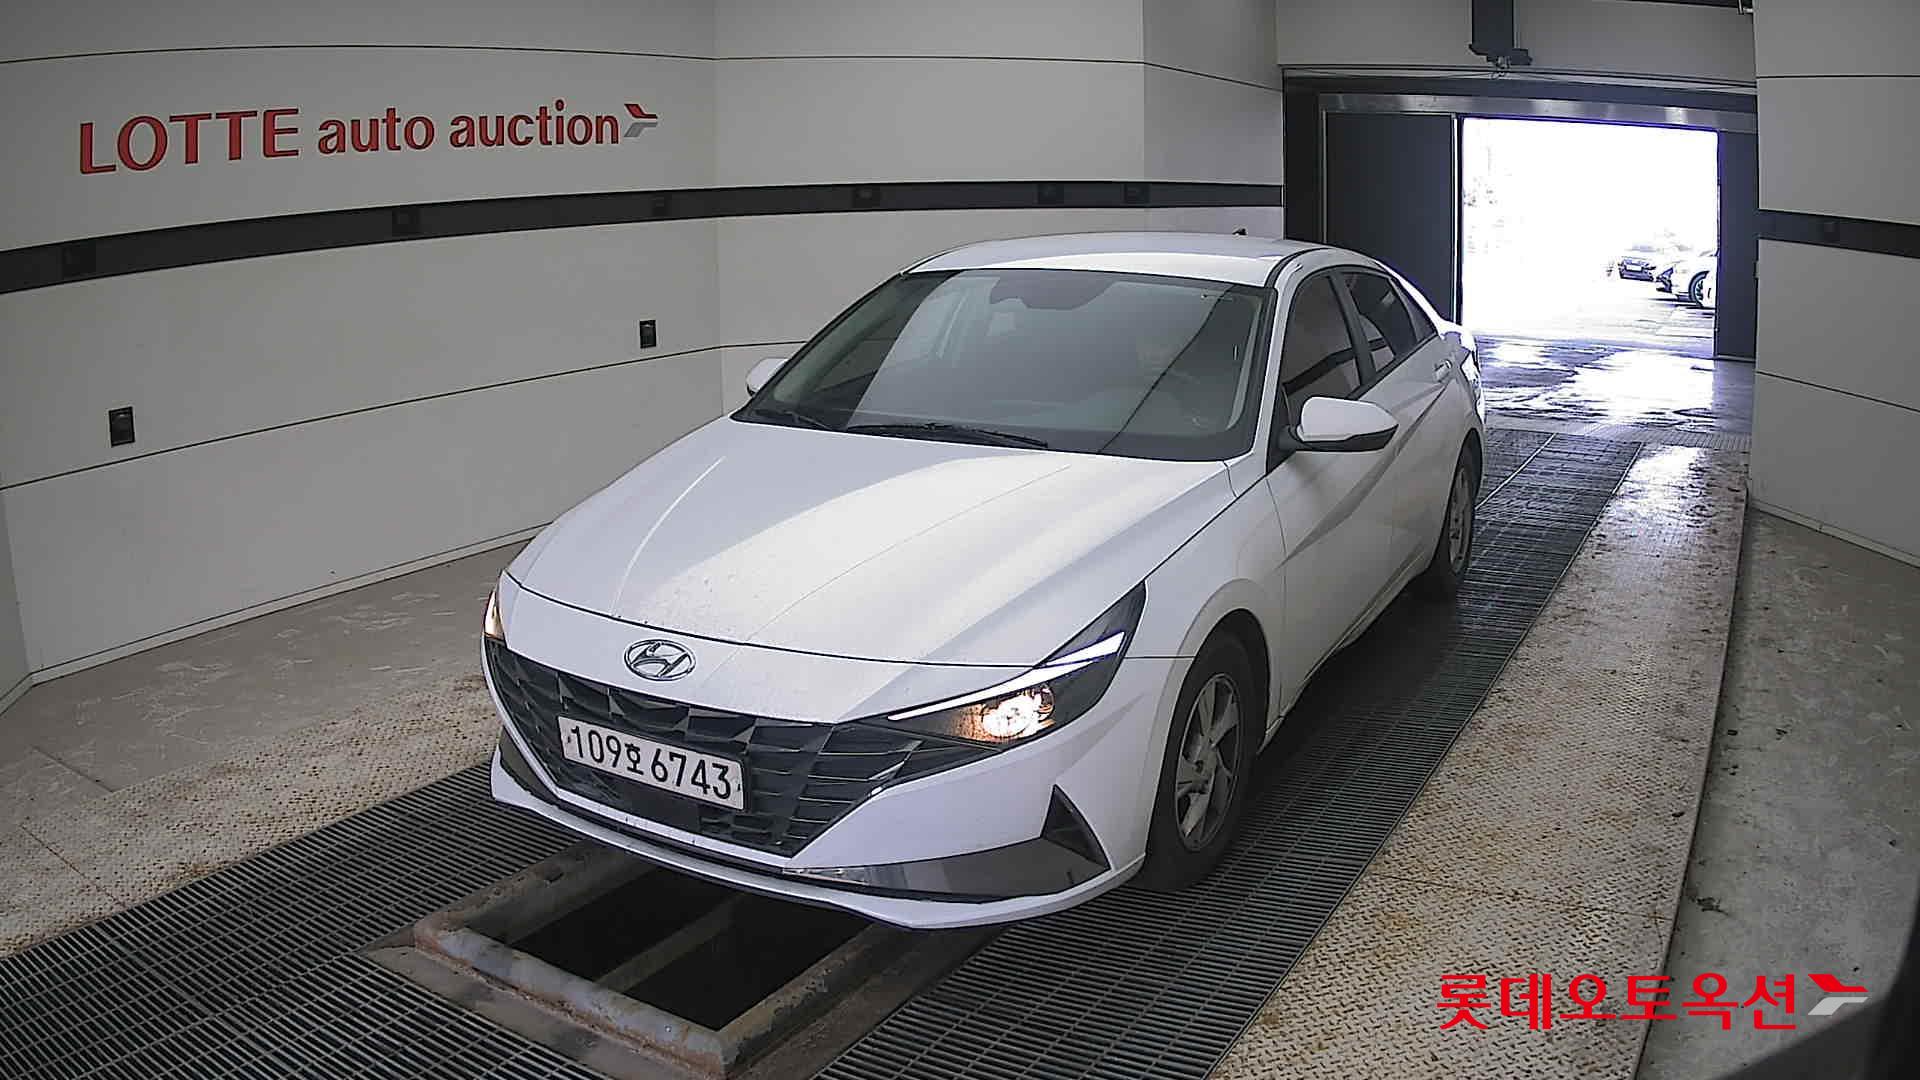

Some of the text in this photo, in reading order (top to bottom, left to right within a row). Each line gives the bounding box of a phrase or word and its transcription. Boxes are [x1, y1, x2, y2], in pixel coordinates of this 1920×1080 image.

[79, 100, 620, 175] LOTTE auto auction
